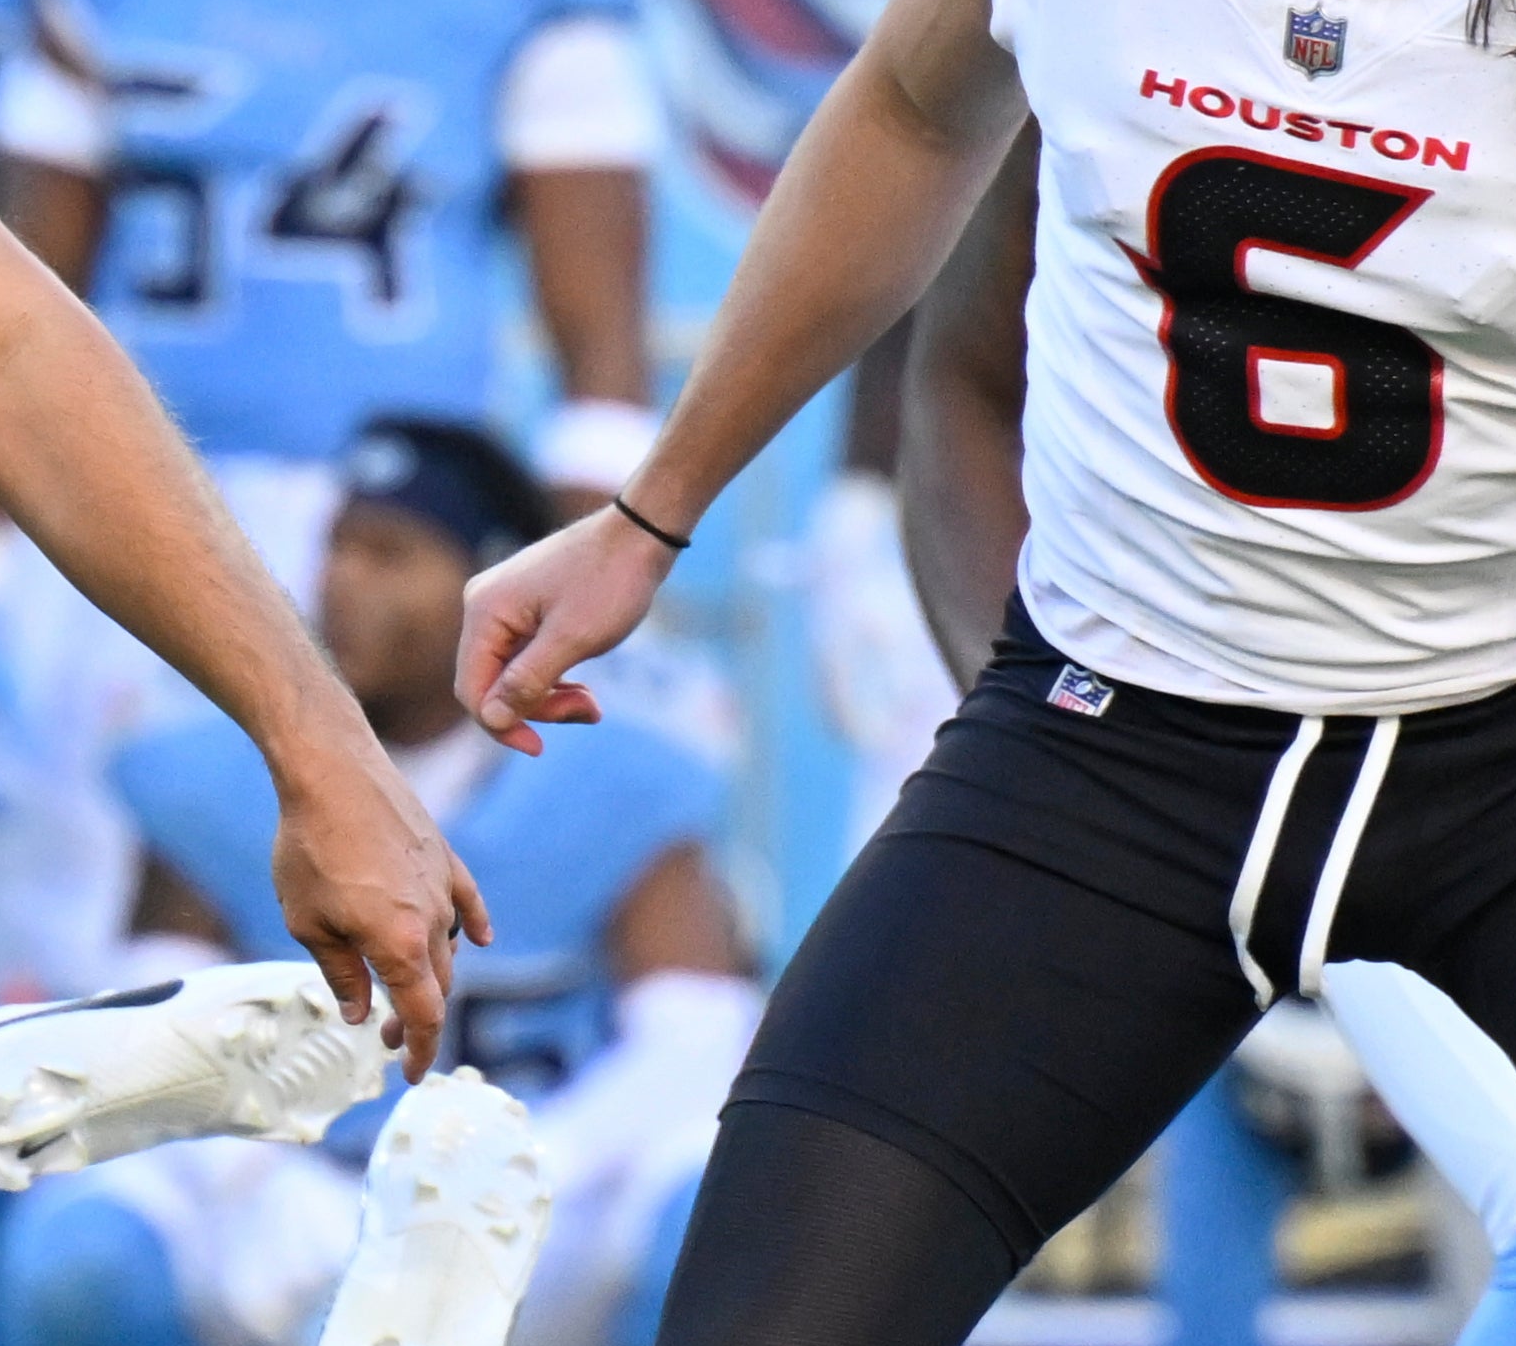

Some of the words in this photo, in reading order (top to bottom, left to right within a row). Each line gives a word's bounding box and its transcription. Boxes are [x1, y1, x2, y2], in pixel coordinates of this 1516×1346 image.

[1293, 35, 1335, 68] NFL
[1139, 68, 1470, 171] HOUSTON
[1125, 144, 1445, 511] 6
